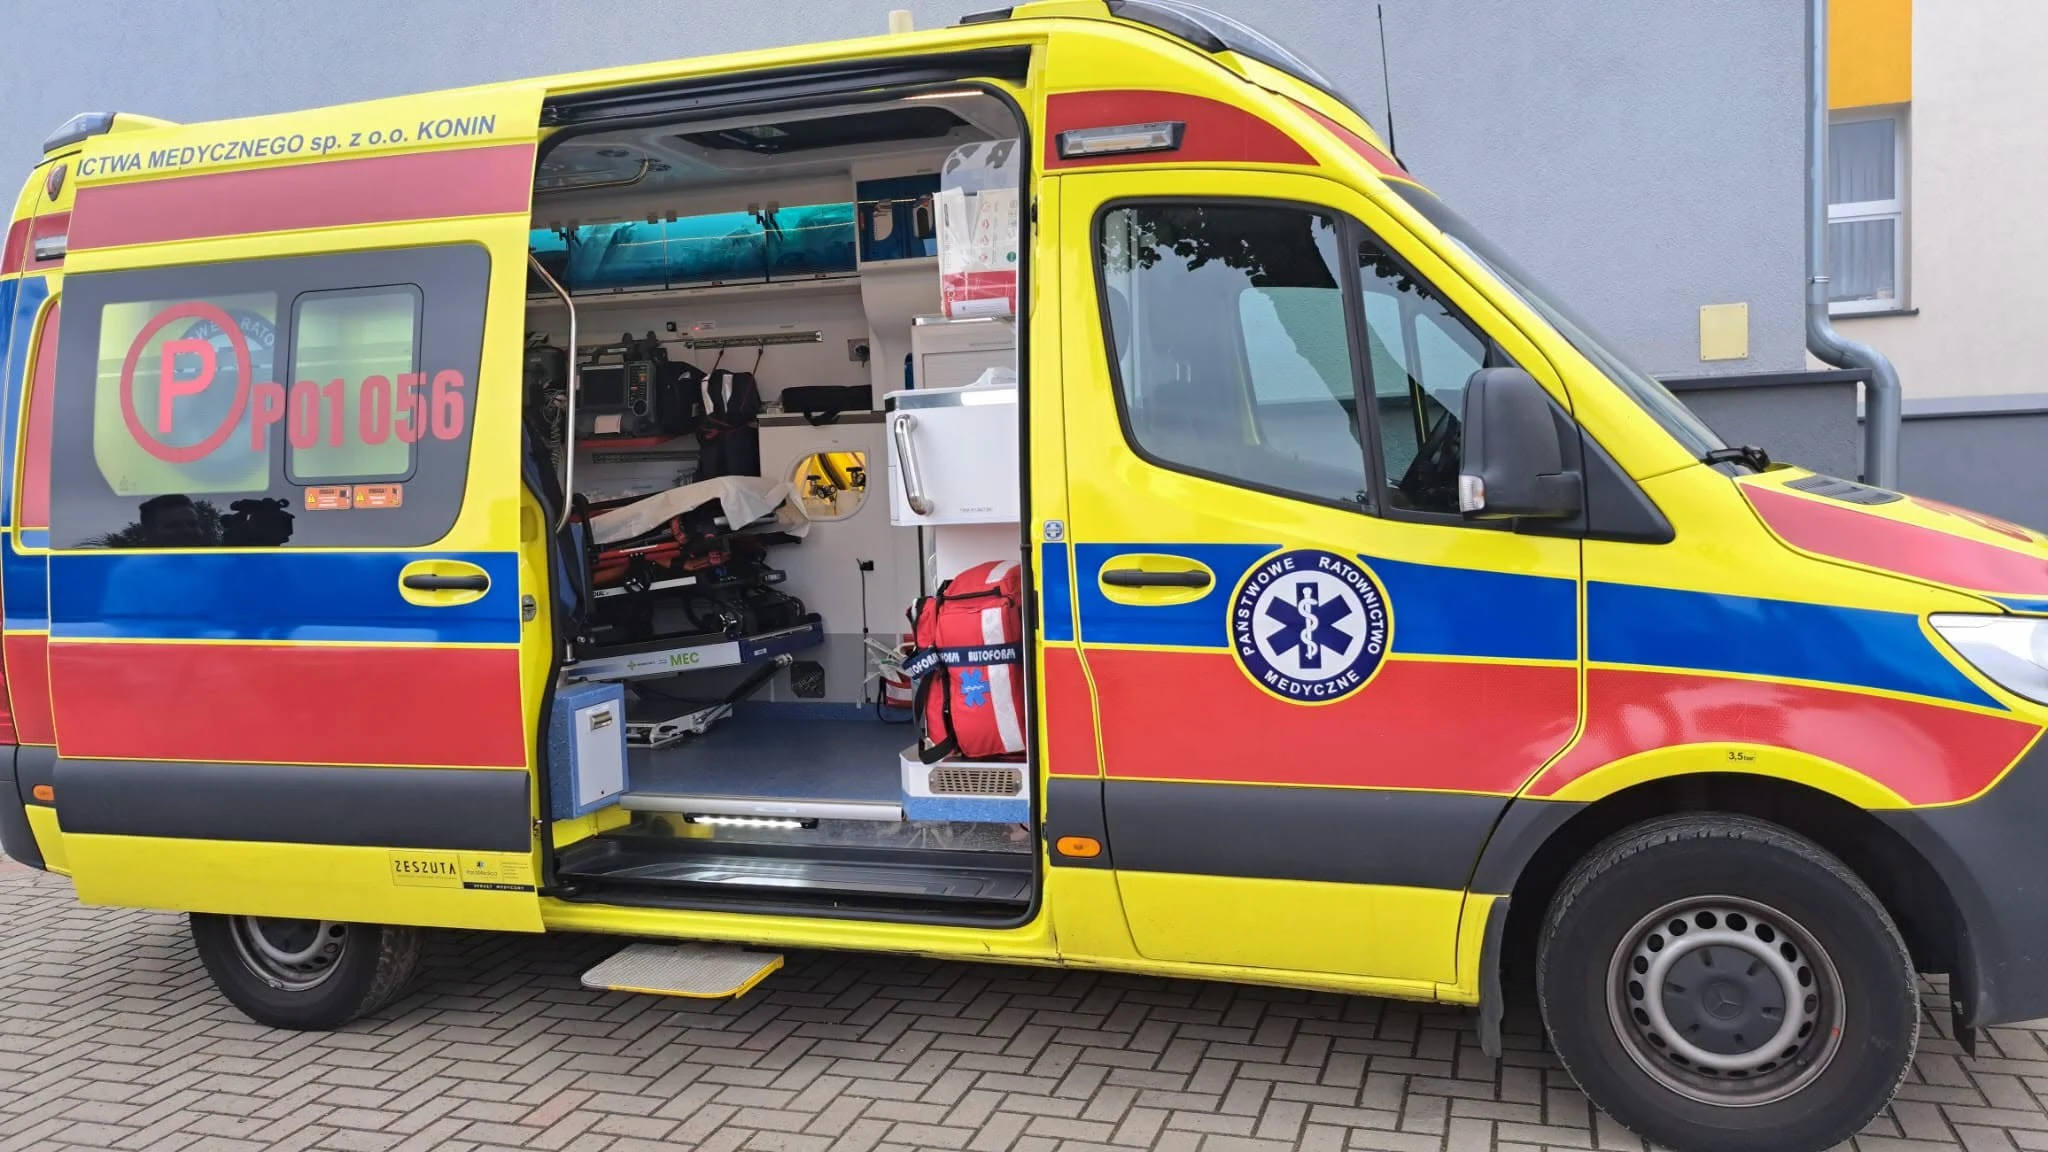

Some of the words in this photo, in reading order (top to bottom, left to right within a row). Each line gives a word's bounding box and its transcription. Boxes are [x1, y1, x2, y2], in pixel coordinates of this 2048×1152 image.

[76, 152, 142, 177] ICTWA
[147, 134, 304, 169] MEDYCZNEGO
[310, 134, 342, 155] sp.
[349, 132, 362, 147] z
[368, 128, 409, 145] o.o.
[417, 114, 496, 141] KONIN
[158, 338, 217, 434] P
[251, 378, 345, 452] P01
[358, 368, 465, 446] 056
[1235, 557, 1296, 657] PAŃSTWOWE
[1318, 556, 1385, 655] RATOWNICTWO
[669, 652, 700, 666] MEC
[968, 648, 1016, 663] AUTOFORM
[1264, 669, 1361, 696] MEDYCZNE
